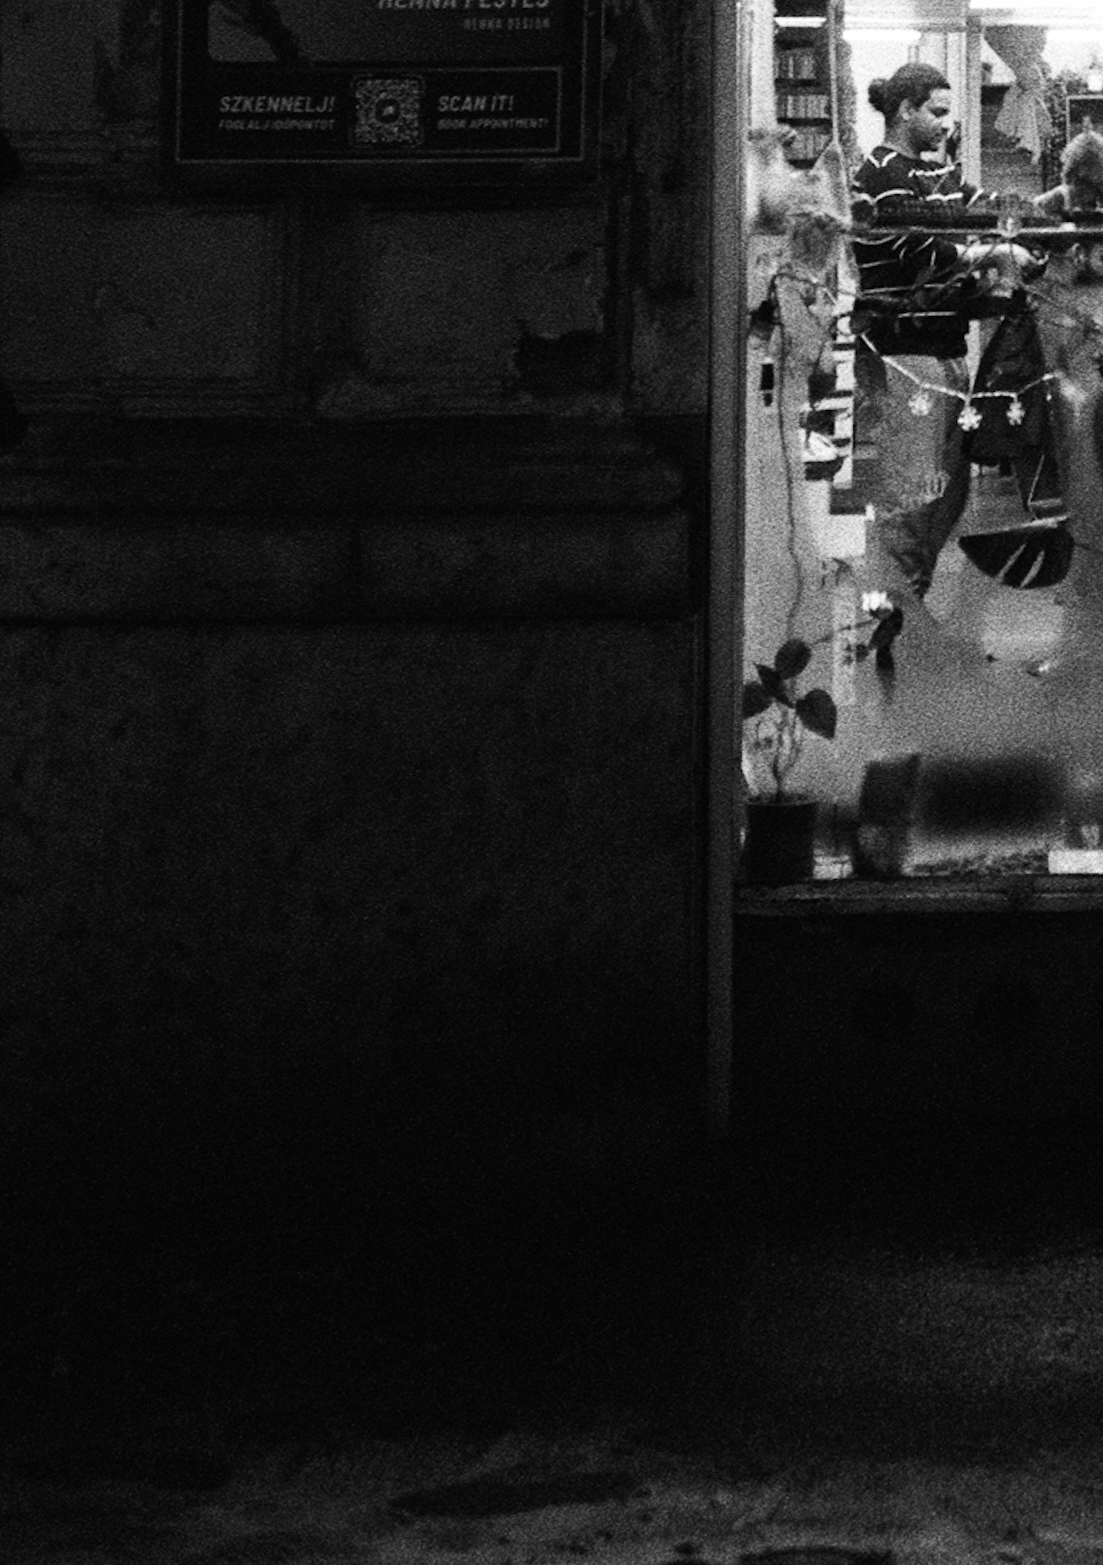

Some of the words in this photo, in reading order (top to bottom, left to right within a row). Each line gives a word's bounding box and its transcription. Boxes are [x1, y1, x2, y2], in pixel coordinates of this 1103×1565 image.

[219, 95, 336, 112] SZKENNELJ!
[437, 95, 487, 112] SCAN
[491, 94, 514, 111] IT!
